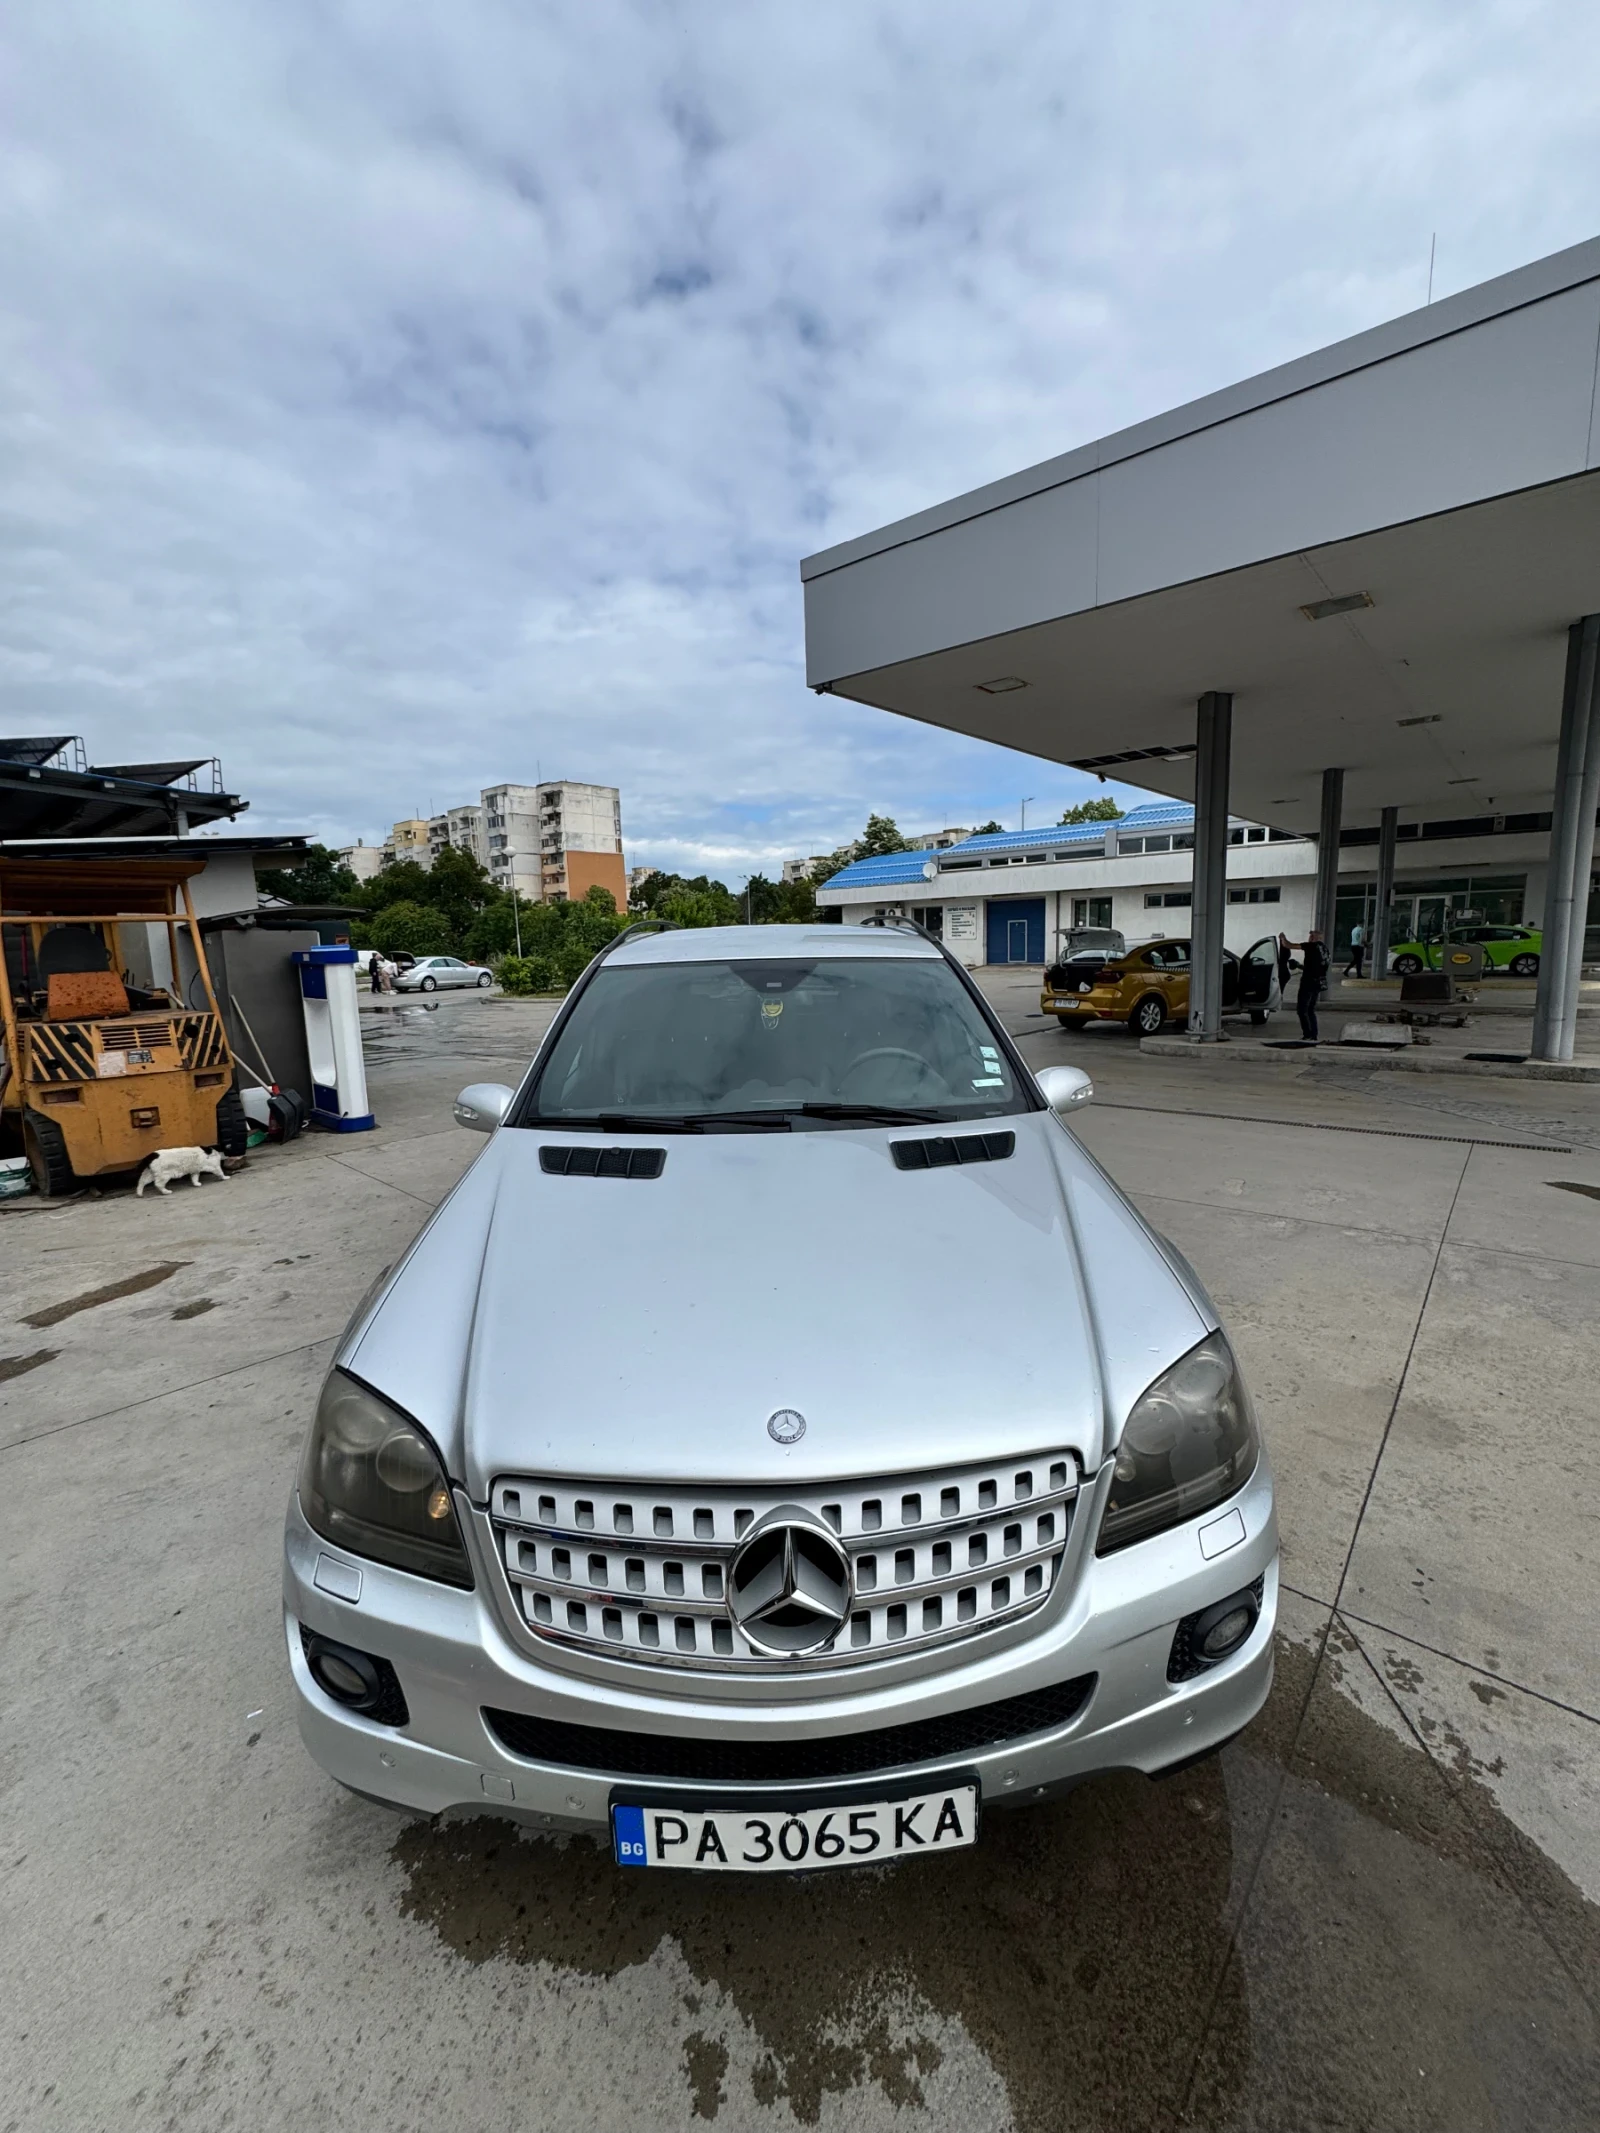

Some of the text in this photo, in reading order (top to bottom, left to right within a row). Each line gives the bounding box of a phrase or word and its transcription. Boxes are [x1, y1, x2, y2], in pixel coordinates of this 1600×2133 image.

[620, 1841, 644, 1856] BG
[653, 1797, 964, 1863] PA 3065 KA
